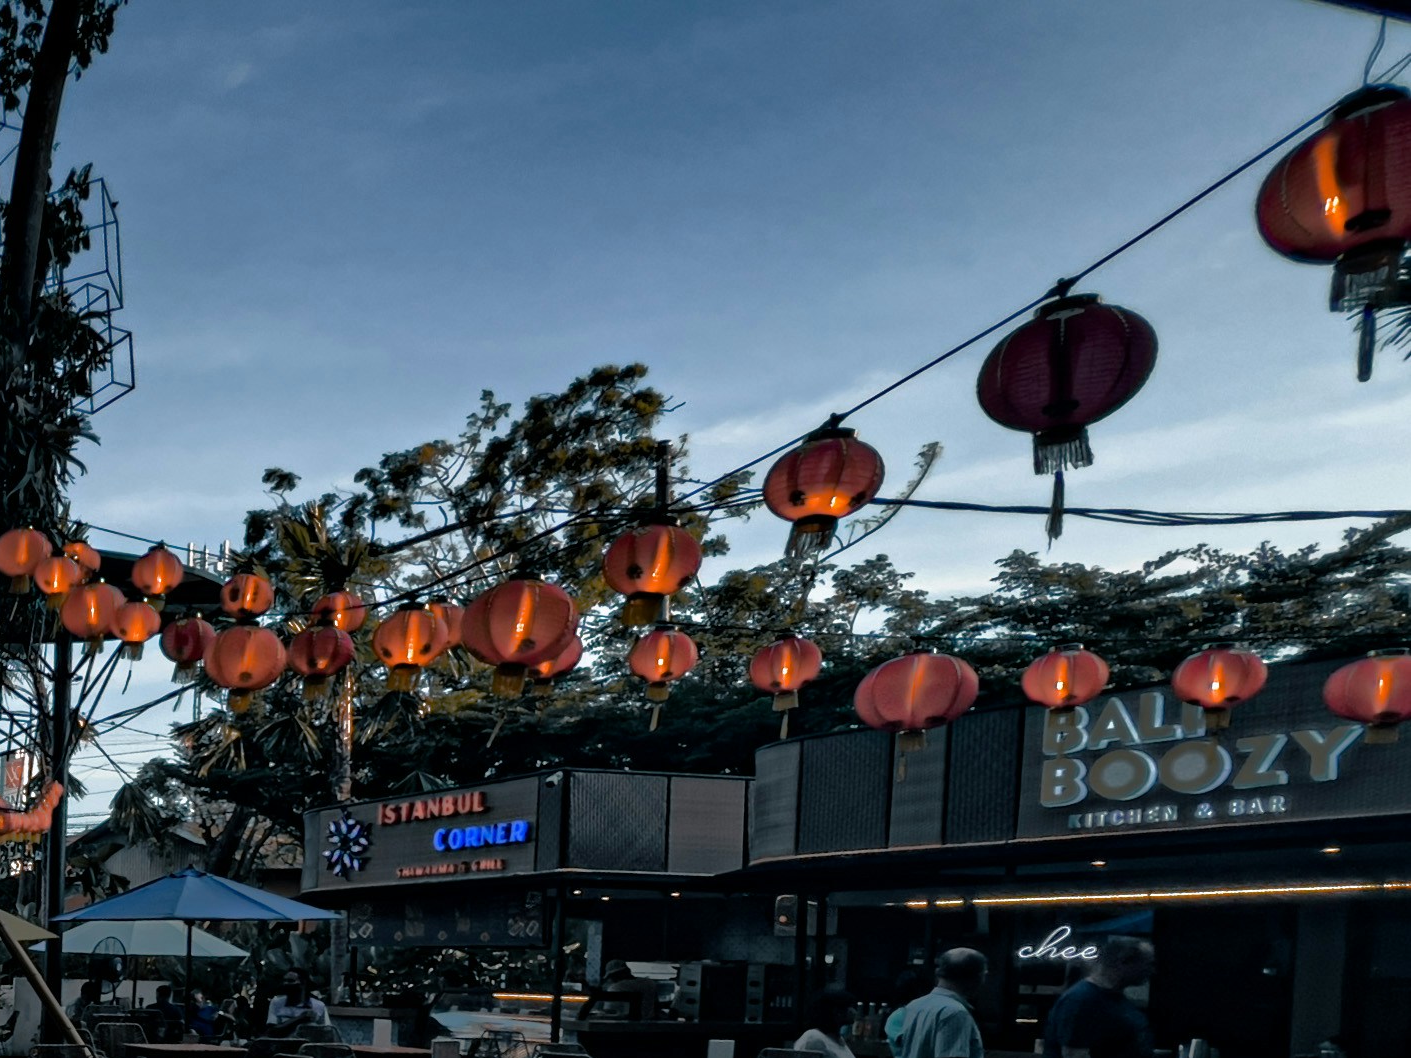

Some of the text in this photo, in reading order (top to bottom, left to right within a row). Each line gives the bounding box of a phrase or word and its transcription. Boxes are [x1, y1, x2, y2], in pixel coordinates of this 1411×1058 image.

[1042, 691, 1207, 755] BALI
[1040, 723, 1366, 808] BOOZY
[377, 791, 487, 826] ISTANBUL
[1067, 795, 1288, 830] KITCHEN & BAR
[433, 819, 531, 852] CORNER
[1018, 925, 1099, 959] chee
